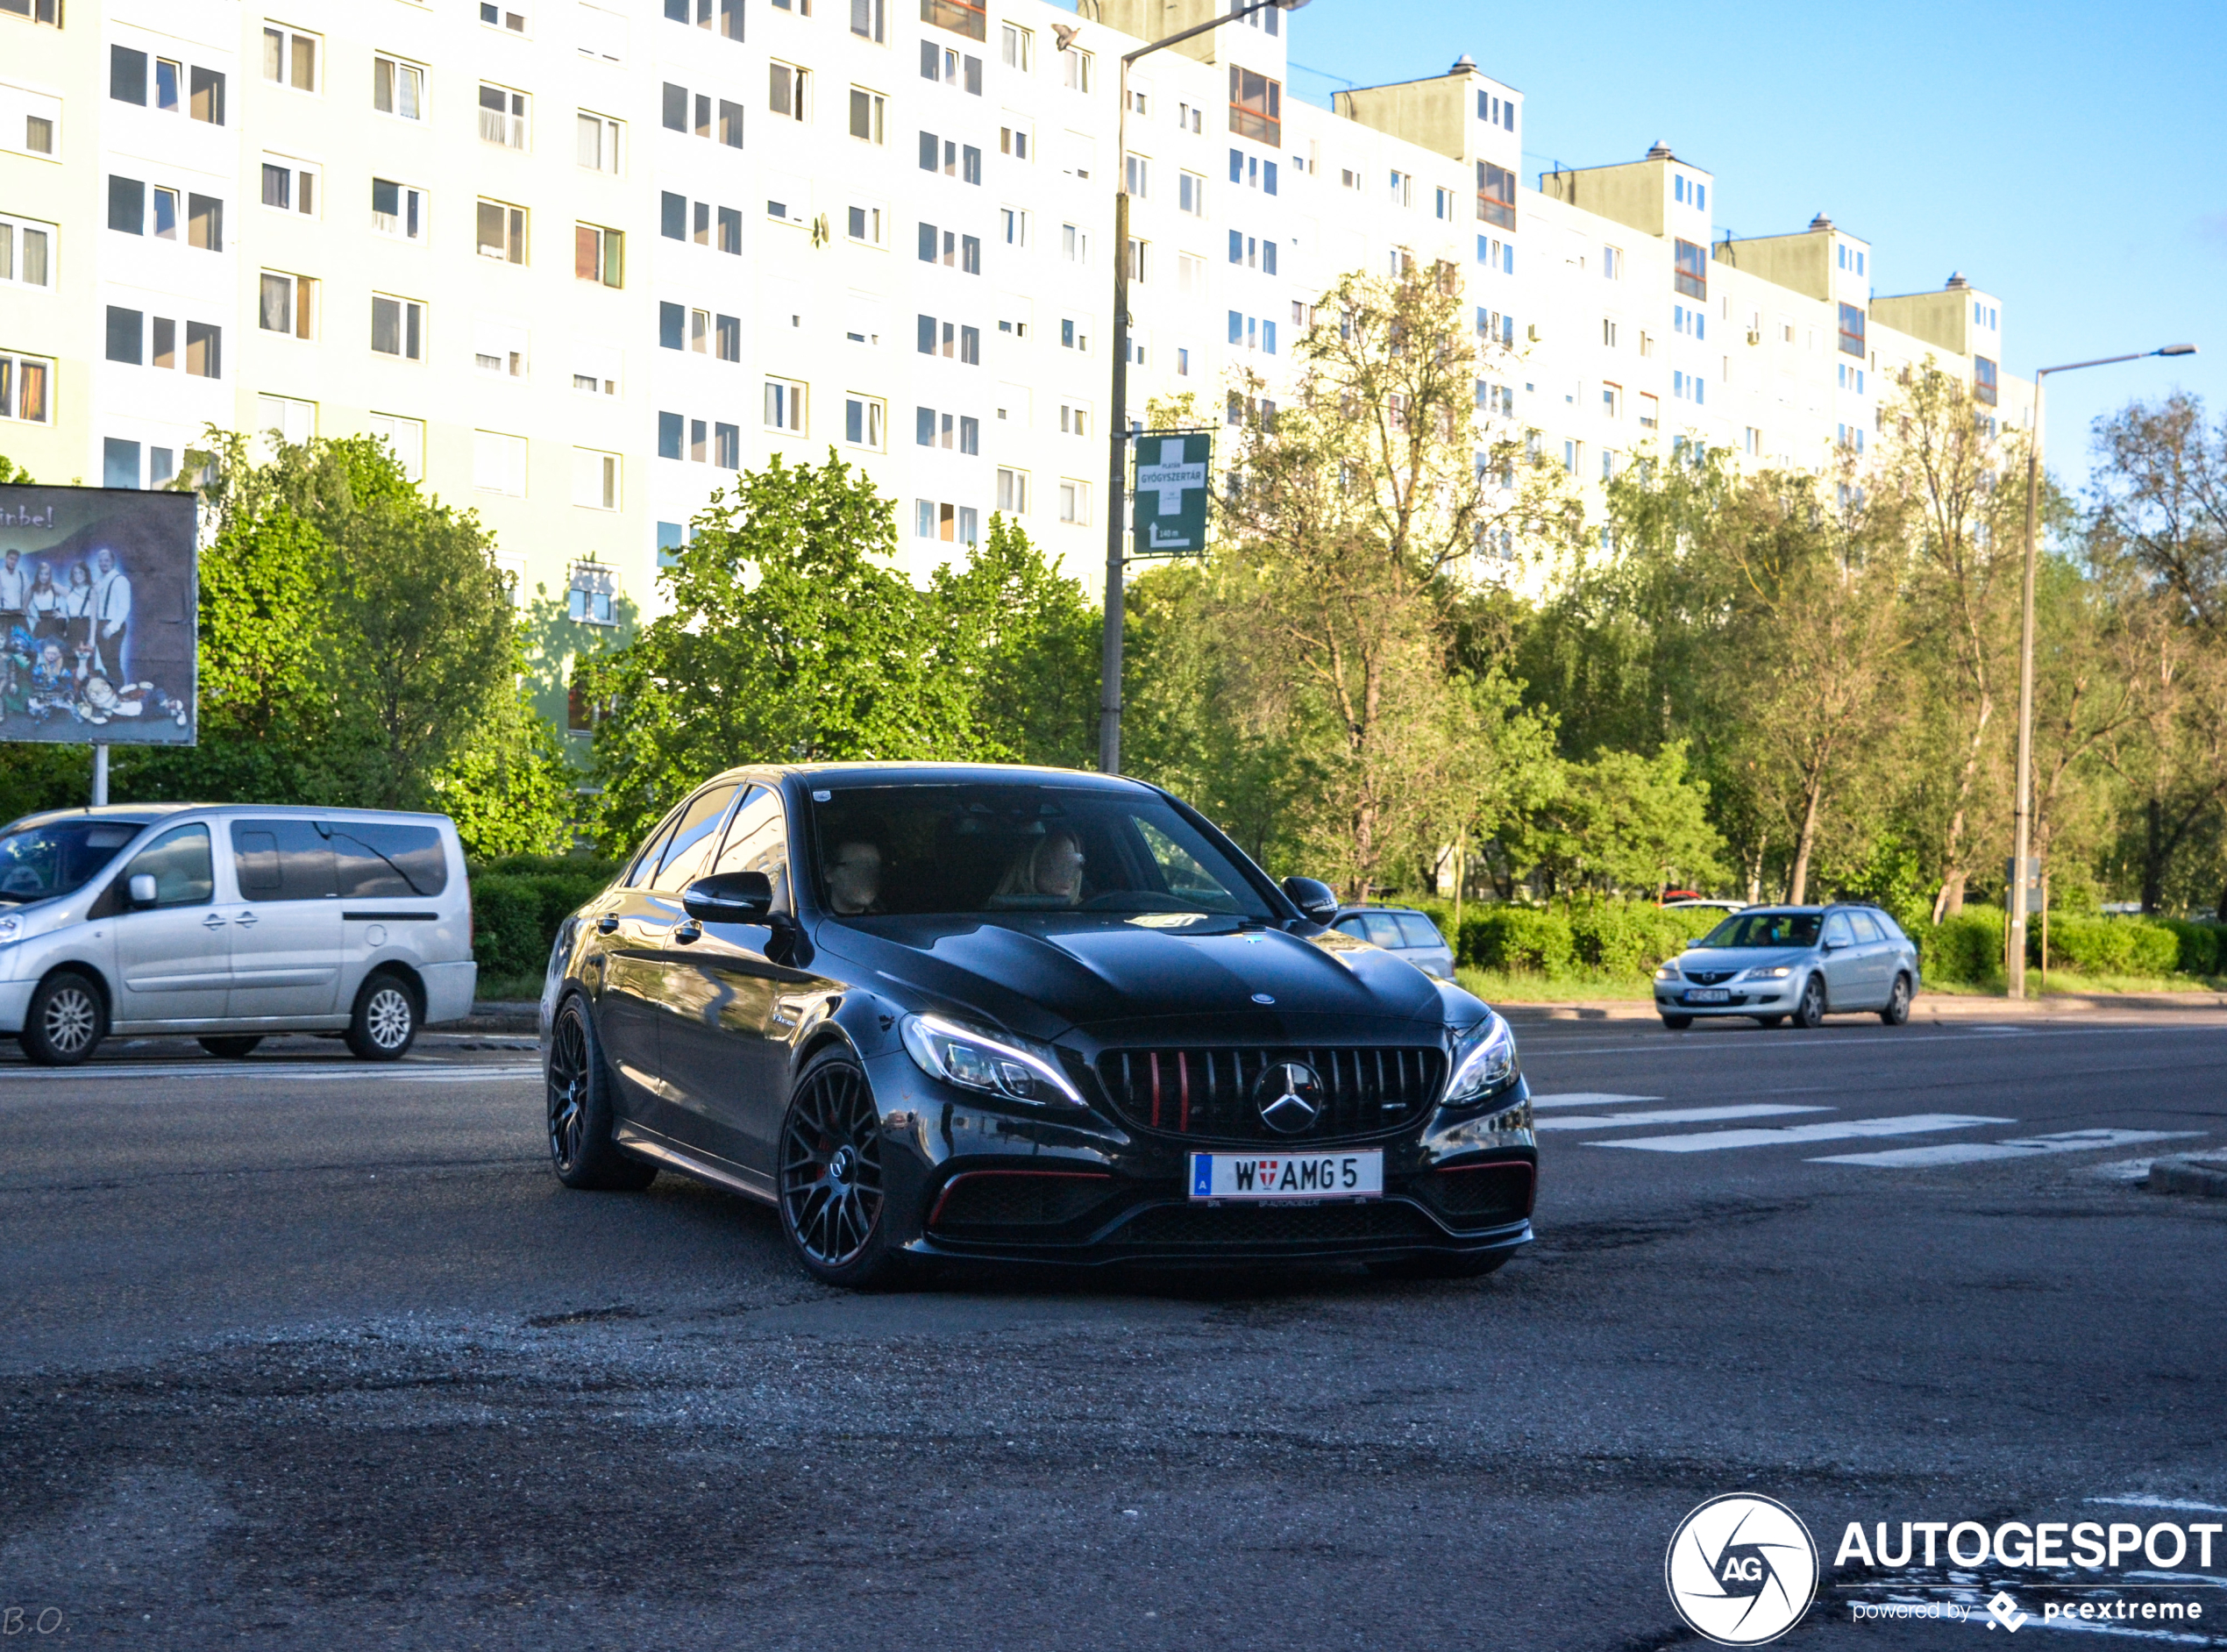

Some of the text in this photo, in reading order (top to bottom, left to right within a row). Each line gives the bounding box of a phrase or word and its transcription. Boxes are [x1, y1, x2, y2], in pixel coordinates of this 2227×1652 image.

[1141, 471, 1201, 483] GYÓGYSZERTÁR
[1236, 1158, 1356, 1190] W AMG 5
[1199, 1180, 1206, 1190] A
